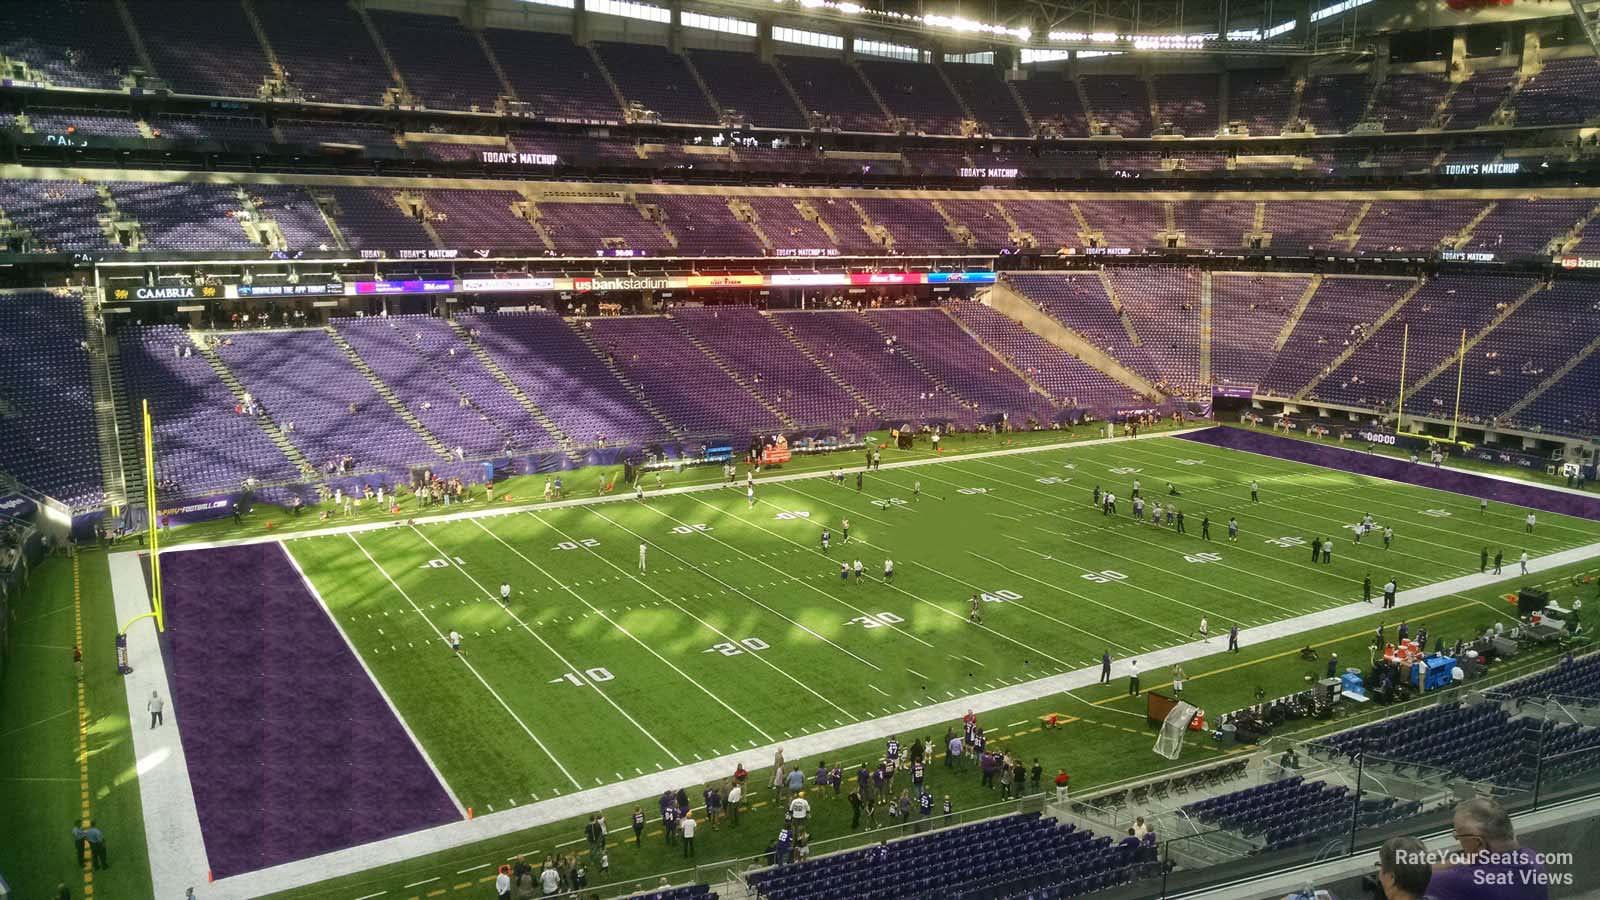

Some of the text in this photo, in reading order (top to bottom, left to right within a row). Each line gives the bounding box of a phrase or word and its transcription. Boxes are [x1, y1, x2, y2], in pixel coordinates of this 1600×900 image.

[482, 151, 558, 166] TODAY'S MATCHUP
[959, 167, 1019, 178] TODAY'S MATCHUP
[1445, 163, 1520, 175] TODAY'S MATCHUP
[399, 249, 458, 258] TODAY'S MATCHUP
[1085, 247, 1132, 256] TODAY'S MATCHUP
[1442, 252, 1495, 262] TODAY'S MATCHUP
[136, 286, 195, 299] CAMBRIA
[1080, 570, 1129, 584] 50
[851, 611, 905, 629] 30
[713, 637, 770, 657] 20
[563, 667, 616, 687] 10
